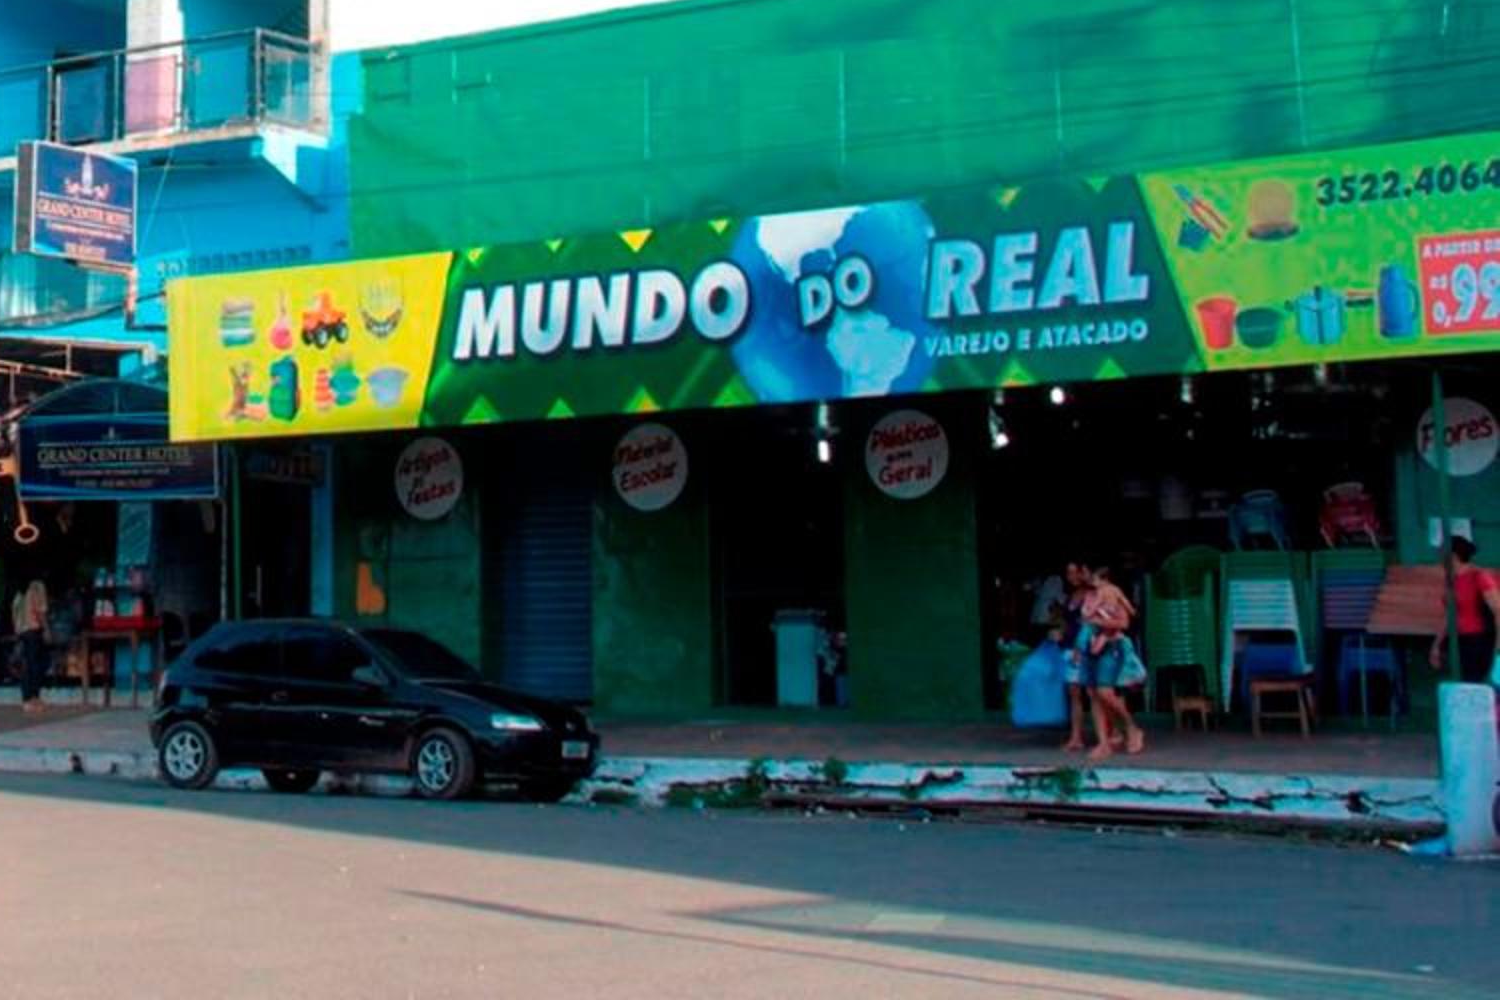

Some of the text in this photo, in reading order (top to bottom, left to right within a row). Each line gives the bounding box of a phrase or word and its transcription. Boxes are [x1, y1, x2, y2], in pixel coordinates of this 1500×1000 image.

[1315, 159, 1500, 207] 3522.4064
[453, 221, 1150, 361] MUNDO DO REAL
[925, 318, 1149, 358] VAREJO E ATACADO
[36, 446, 87, 464] GRAND
[89, 445, 145, 463] CENTER
